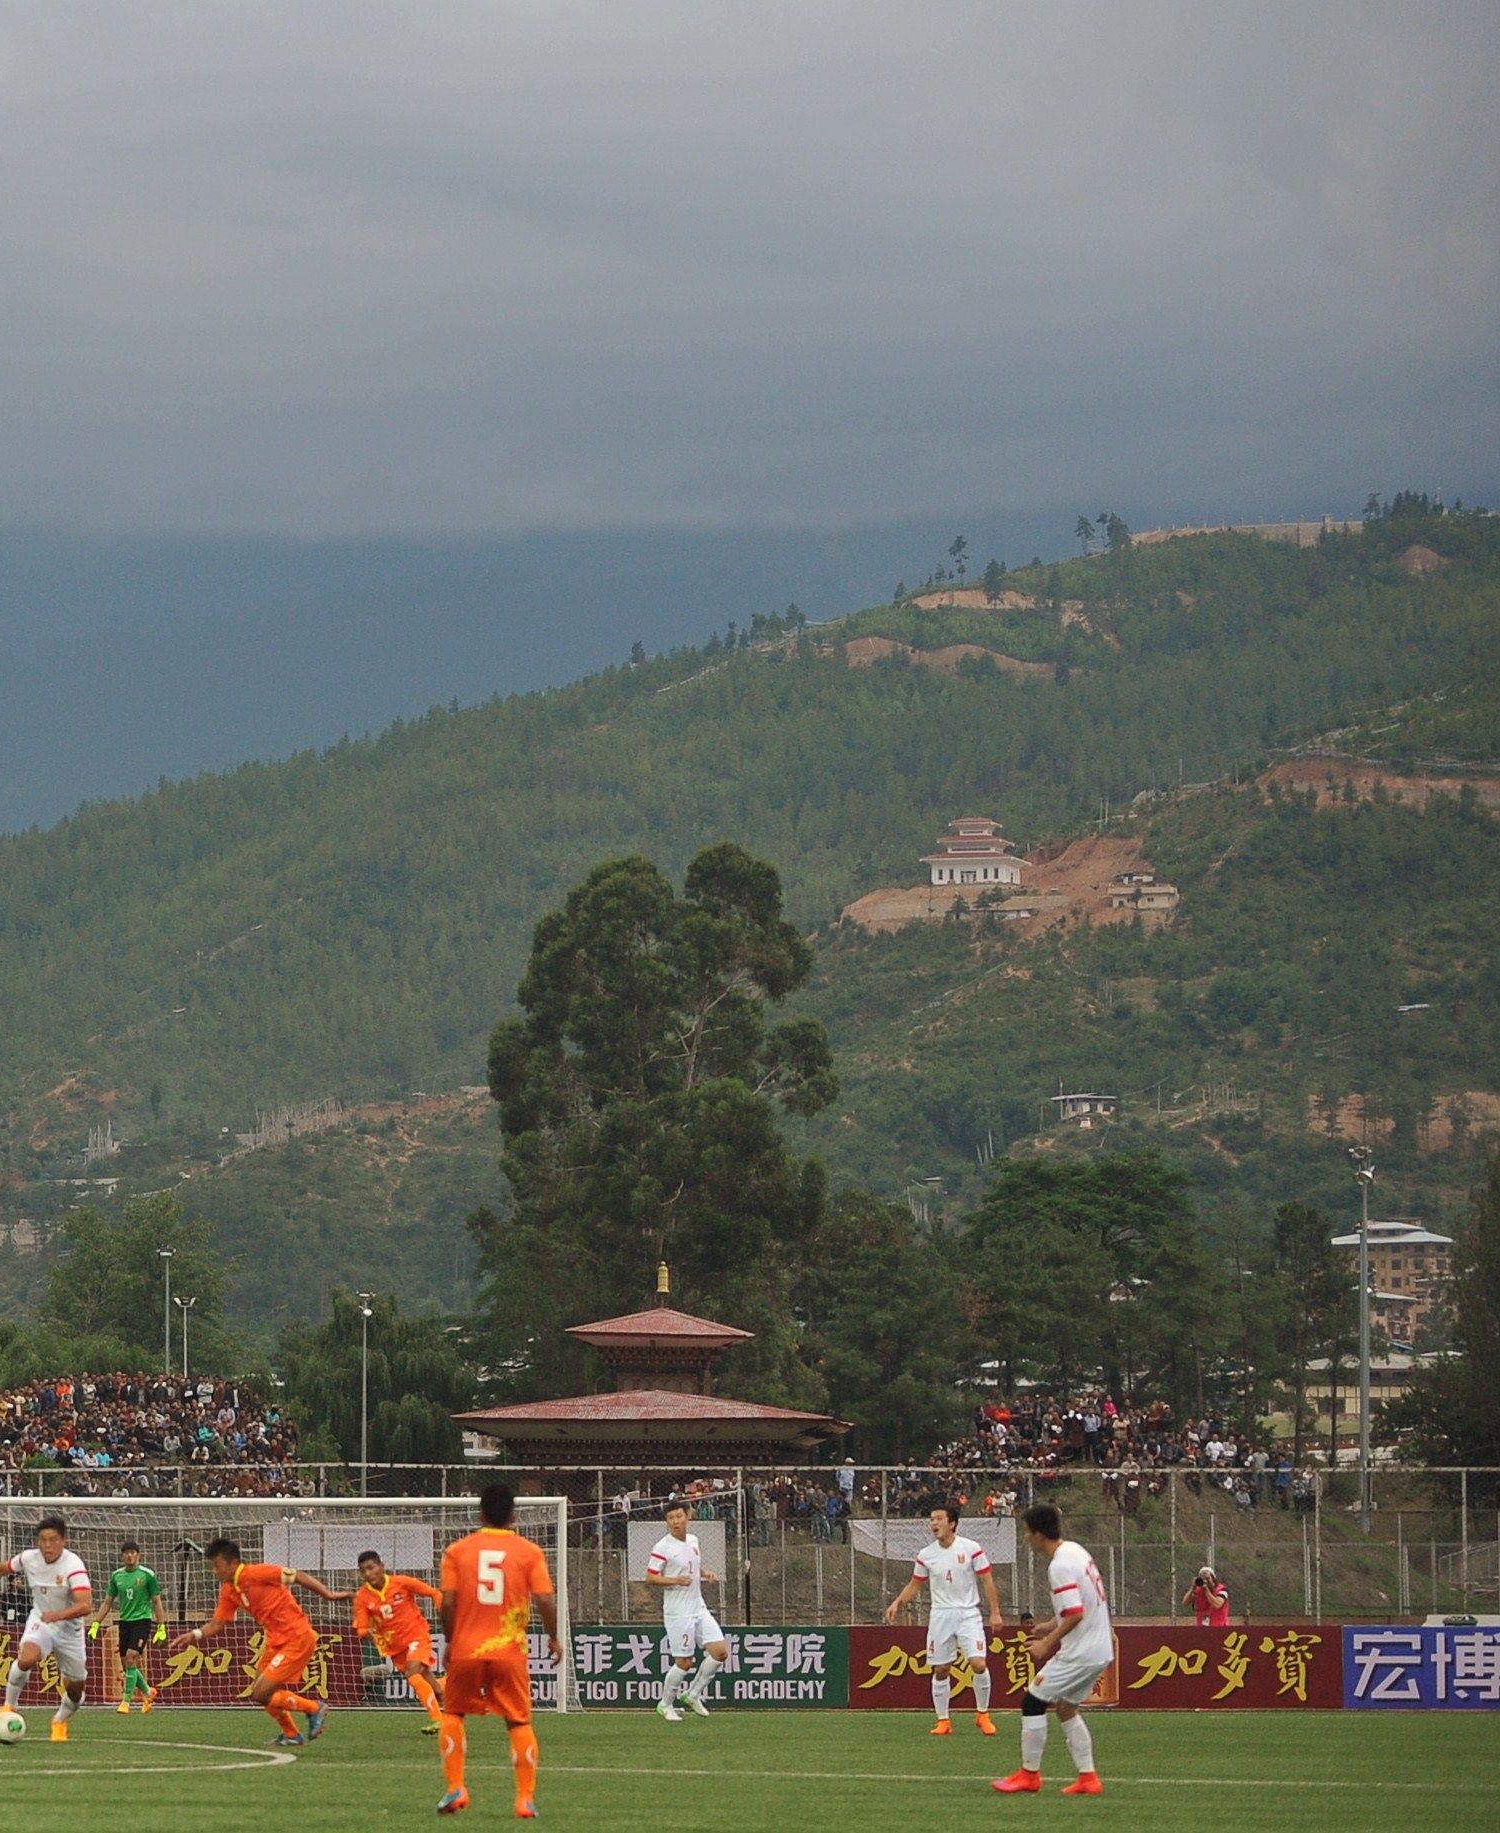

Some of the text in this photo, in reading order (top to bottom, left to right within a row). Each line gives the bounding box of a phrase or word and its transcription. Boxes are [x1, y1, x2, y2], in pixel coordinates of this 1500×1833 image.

[477, 1550, 506, 1605] 5
[945, 1569, 953, 1584] 4
[126, 1588, 134, 1600] 12
[683, 1633, 690, 1647] 2
[1353, 1631, 1500, 1699] 宏博
[575, 1681, 618, 1700] FIGO
[734, 1680, 826, 1699] ACADEMY
